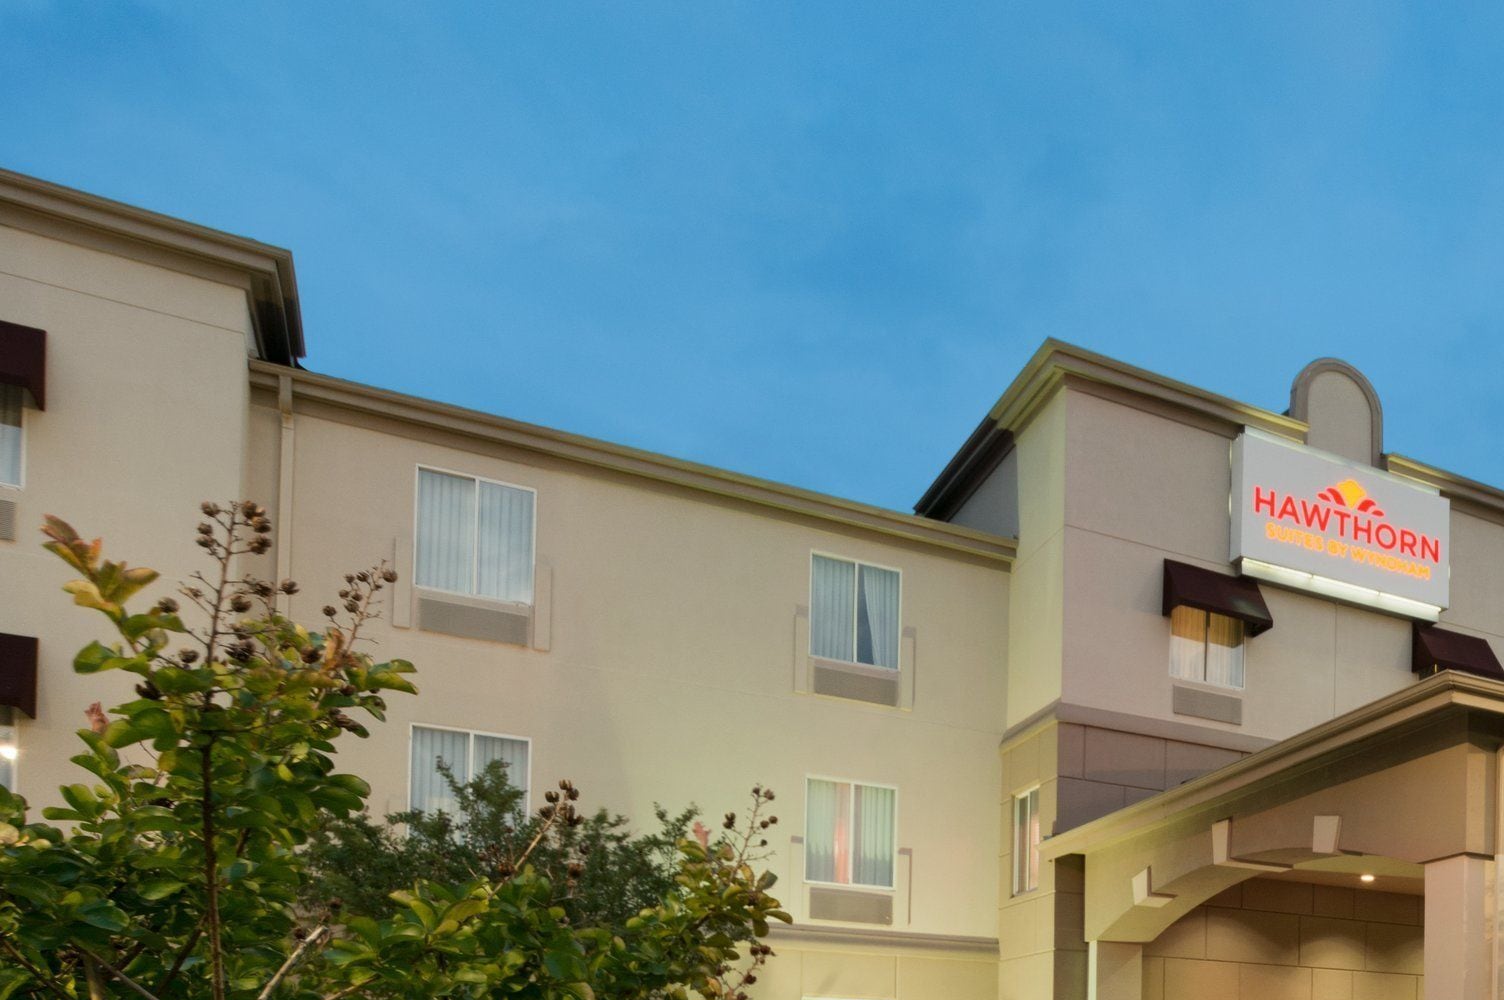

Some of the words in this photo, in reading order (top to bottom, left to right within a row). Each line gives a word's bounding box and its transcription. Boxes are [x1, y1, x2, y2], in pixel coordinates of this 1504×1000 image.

[1254, 486, 1440, 564] HAWTHORN
[1266, 522, 1323, 551] SUITES
[1327, 539, 1348, 559] BY
[1351, 546, 1431, 580] WYNDHAM
